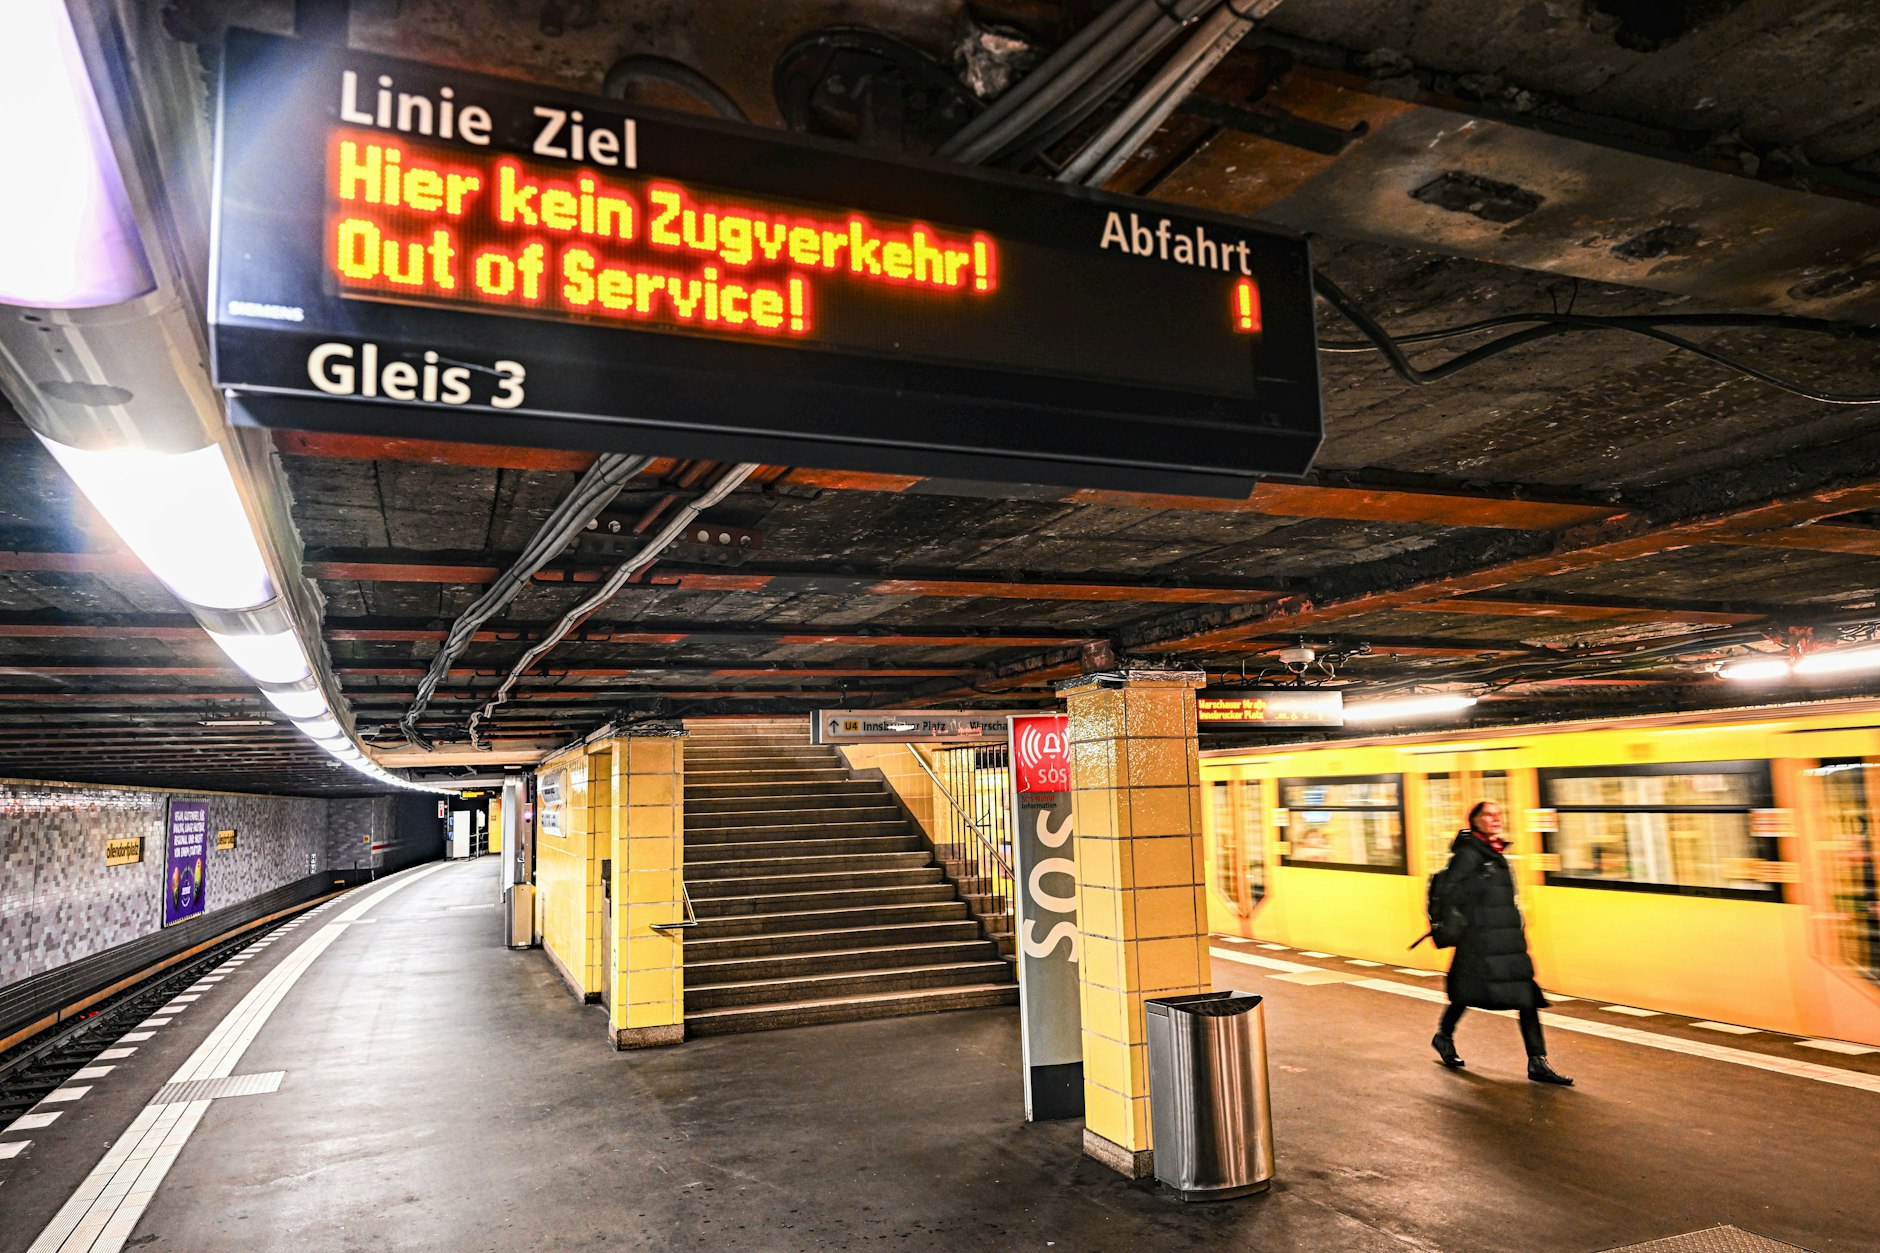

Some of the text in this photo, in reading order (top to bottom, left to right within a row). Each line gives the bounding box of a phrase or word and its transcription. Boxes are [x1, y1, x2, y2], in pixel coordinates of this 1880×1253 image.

[340, 69, 637, 169] Linie Ziel
[338, 139, 988, 290] Hier kein Zugverkehr!
[1100, 211, 1252, 275] Abfahrt
[336, 217, 804, 331] Out of Service!
[1238, 283, 1252, 329] !
[307, 343, 527, 409] Gleis 3
[845, 721, 858, 731] U4
[863, 721, 920, 731] Innsbrer
[922, 721, 946, 731] Platz
[1038, 768, 1068, 784] SOS
[1022, 809, 1079, 963] SOS
